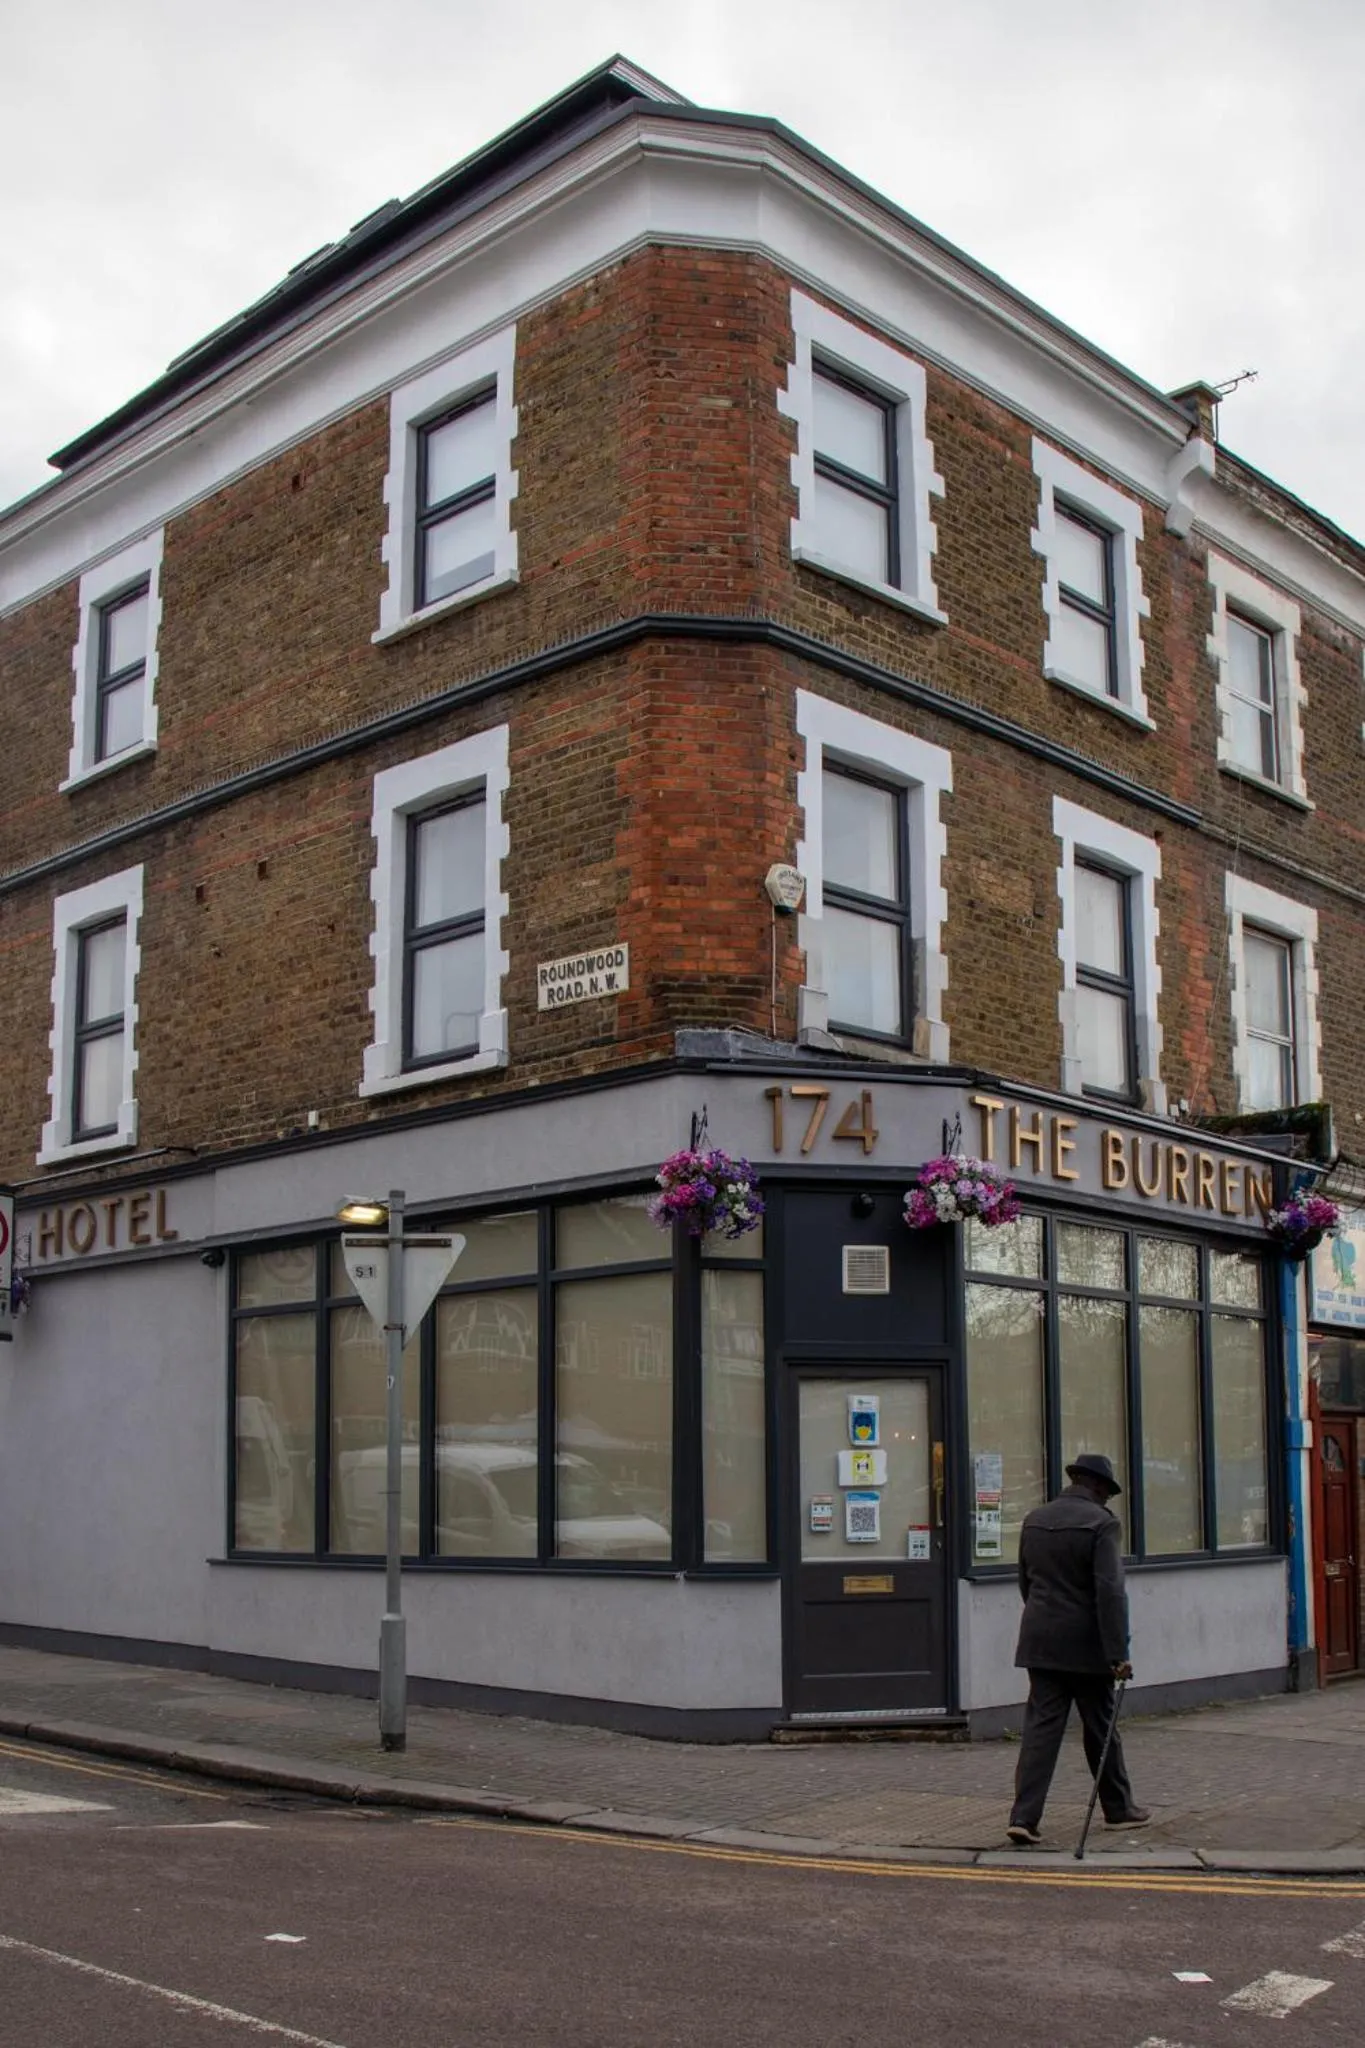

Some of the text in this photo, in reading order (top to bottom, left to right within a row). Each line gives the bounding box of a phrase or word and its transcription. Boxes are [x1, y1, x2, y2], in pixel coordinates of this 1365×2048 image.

[540, 950, 624, 986] ROUNDWOOD
[764, 1084, 879, 1155] 174
[970, 1095, 1274, 1222] THE BURREN
[37, 1189, 178, 1258] HOTEL
